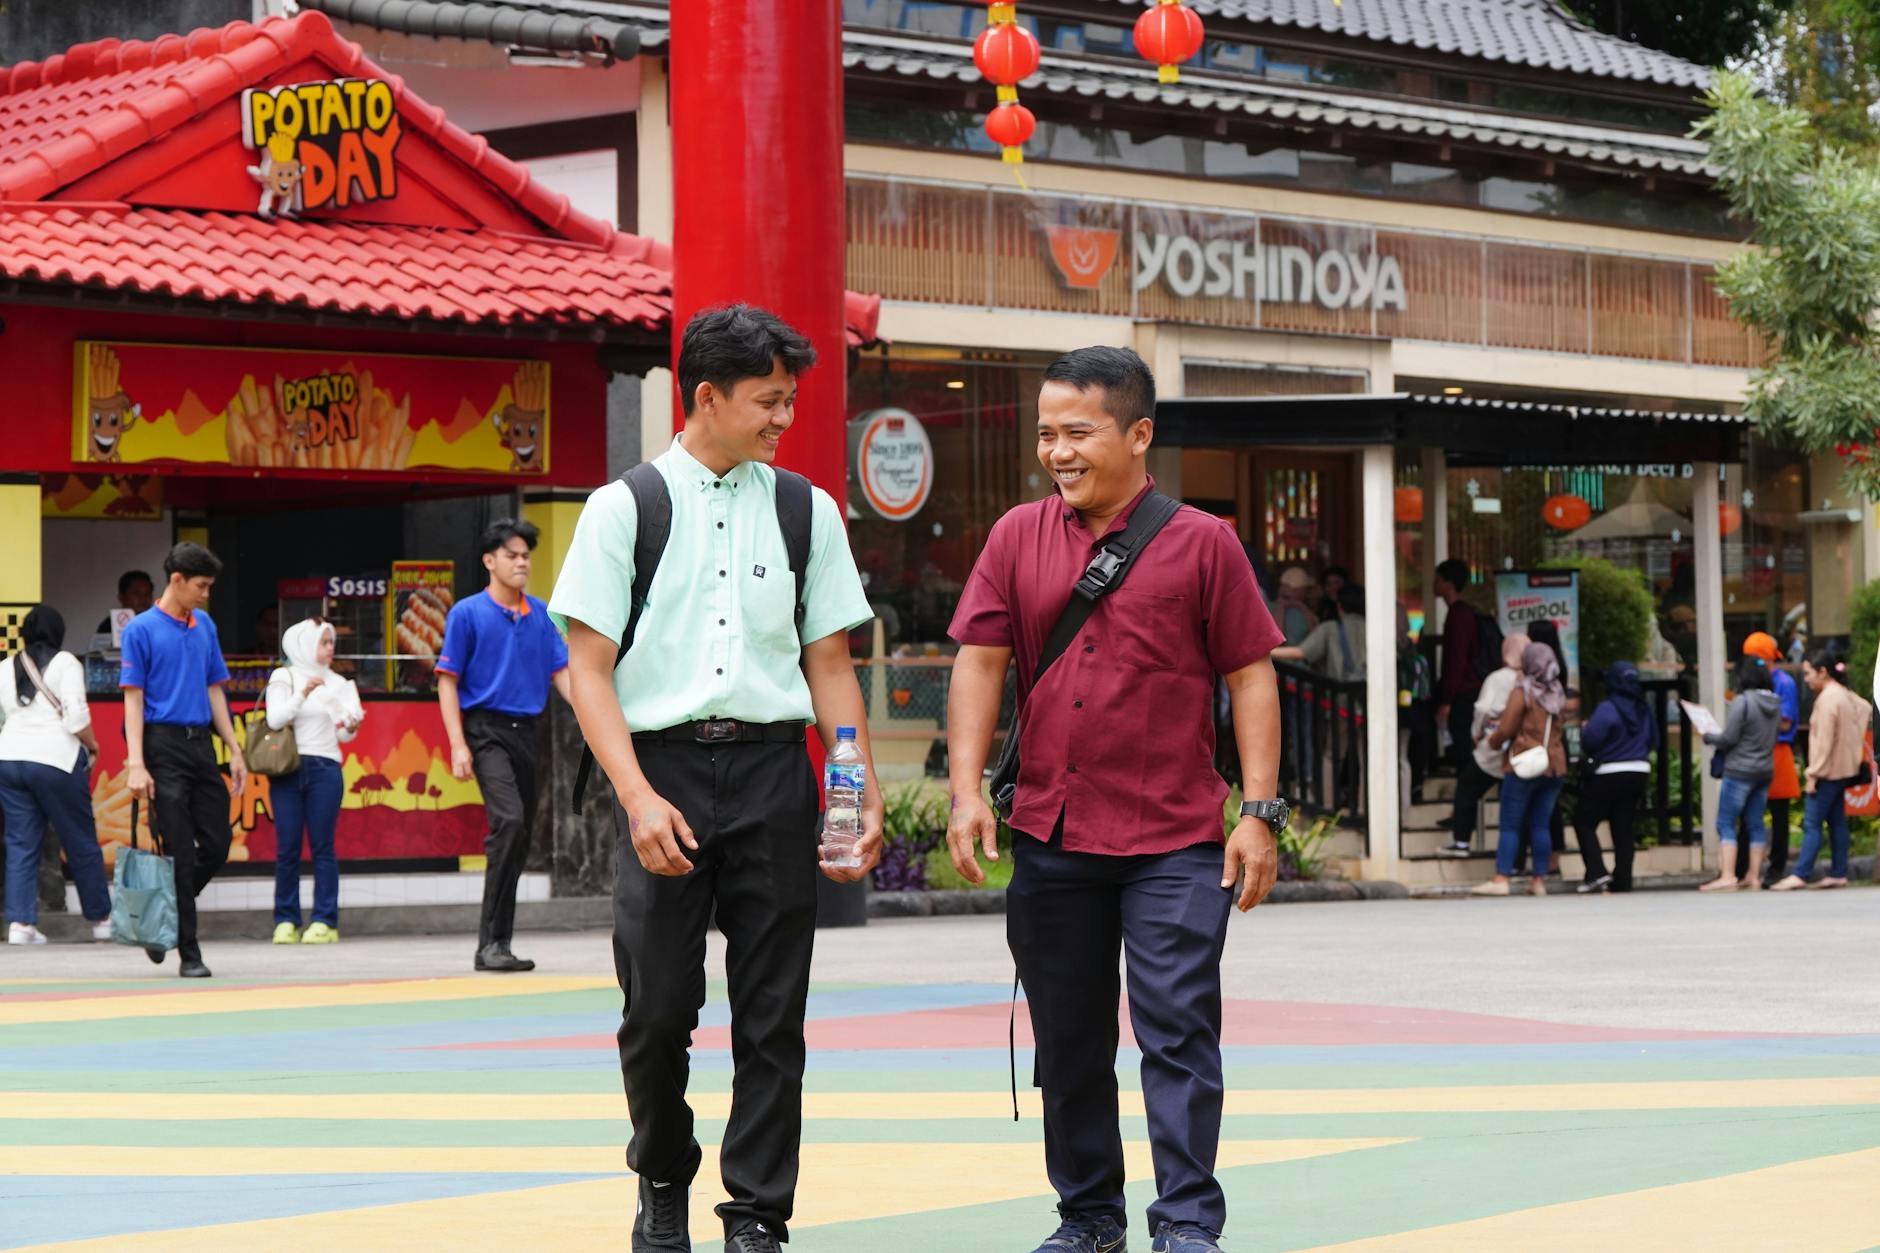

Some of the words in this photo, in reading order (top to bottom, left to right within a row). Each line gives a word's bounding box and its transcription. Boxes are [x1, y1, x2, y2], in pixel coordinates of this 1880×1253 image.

[250, 80, 393, 148] POTATO
[298, 112, 401, 209] DAY
[283, 374, 355, 415] POTATO
[307, 396, 359, 448] DAY
[1507, 600, 1571, 621] CENDOL
